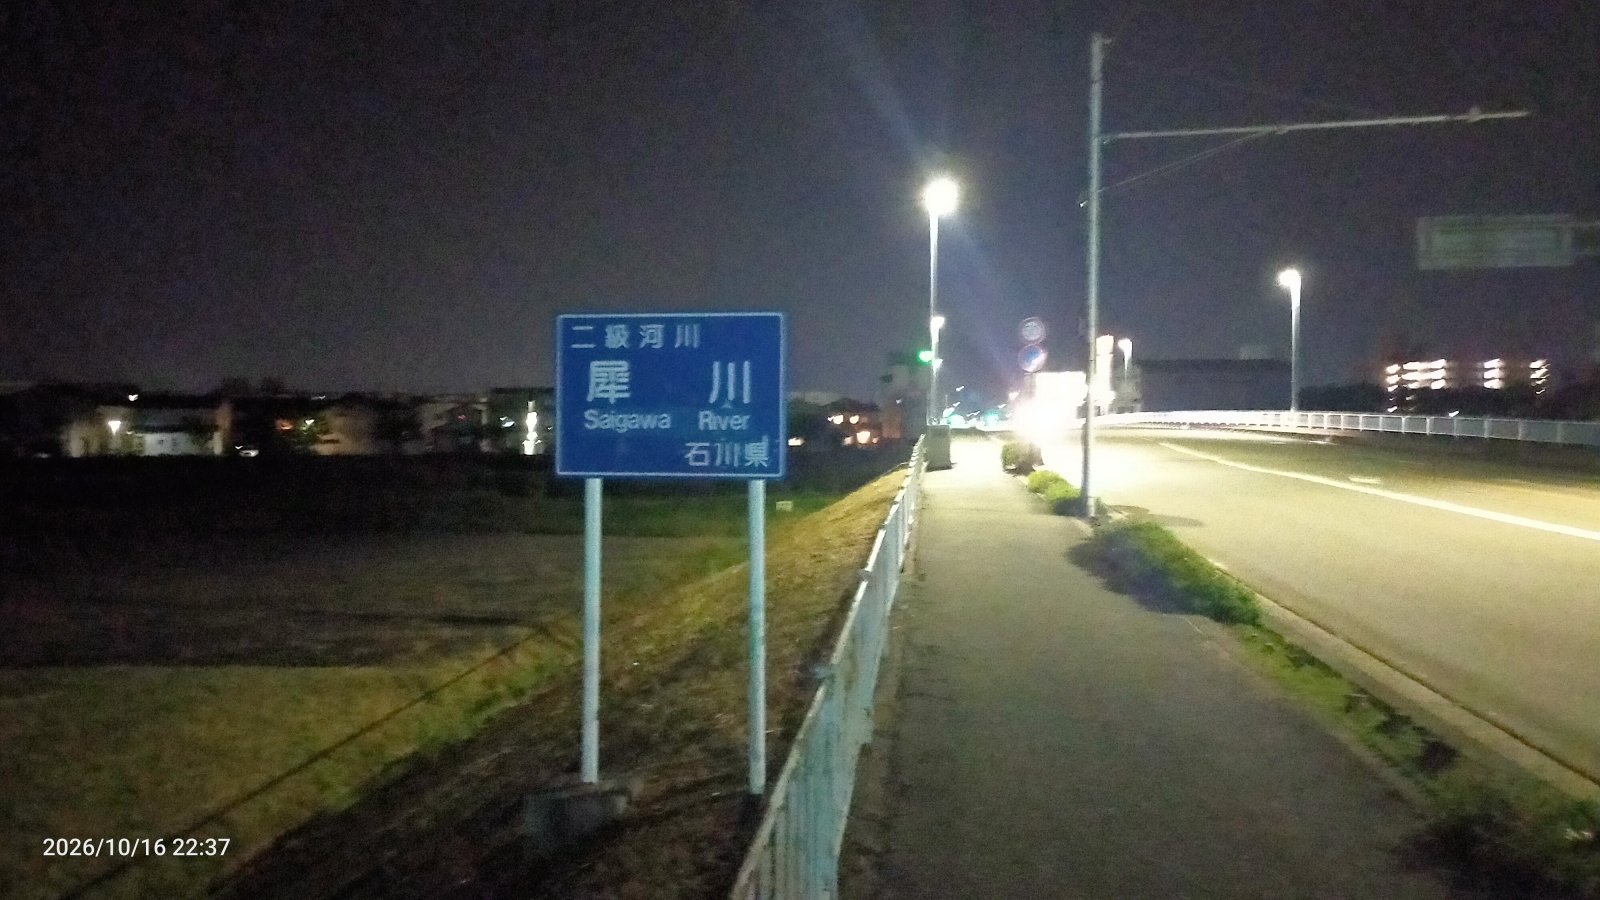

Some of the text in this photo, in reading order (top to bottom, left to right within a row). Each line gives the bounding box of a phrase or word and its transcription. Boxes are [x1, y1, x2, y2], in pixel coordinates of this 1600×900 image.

[570, 323, 700, 349] 二級河川
[583, 409, 750, 434] Saigawa River
[684, 440, 769, 468] 石川県
